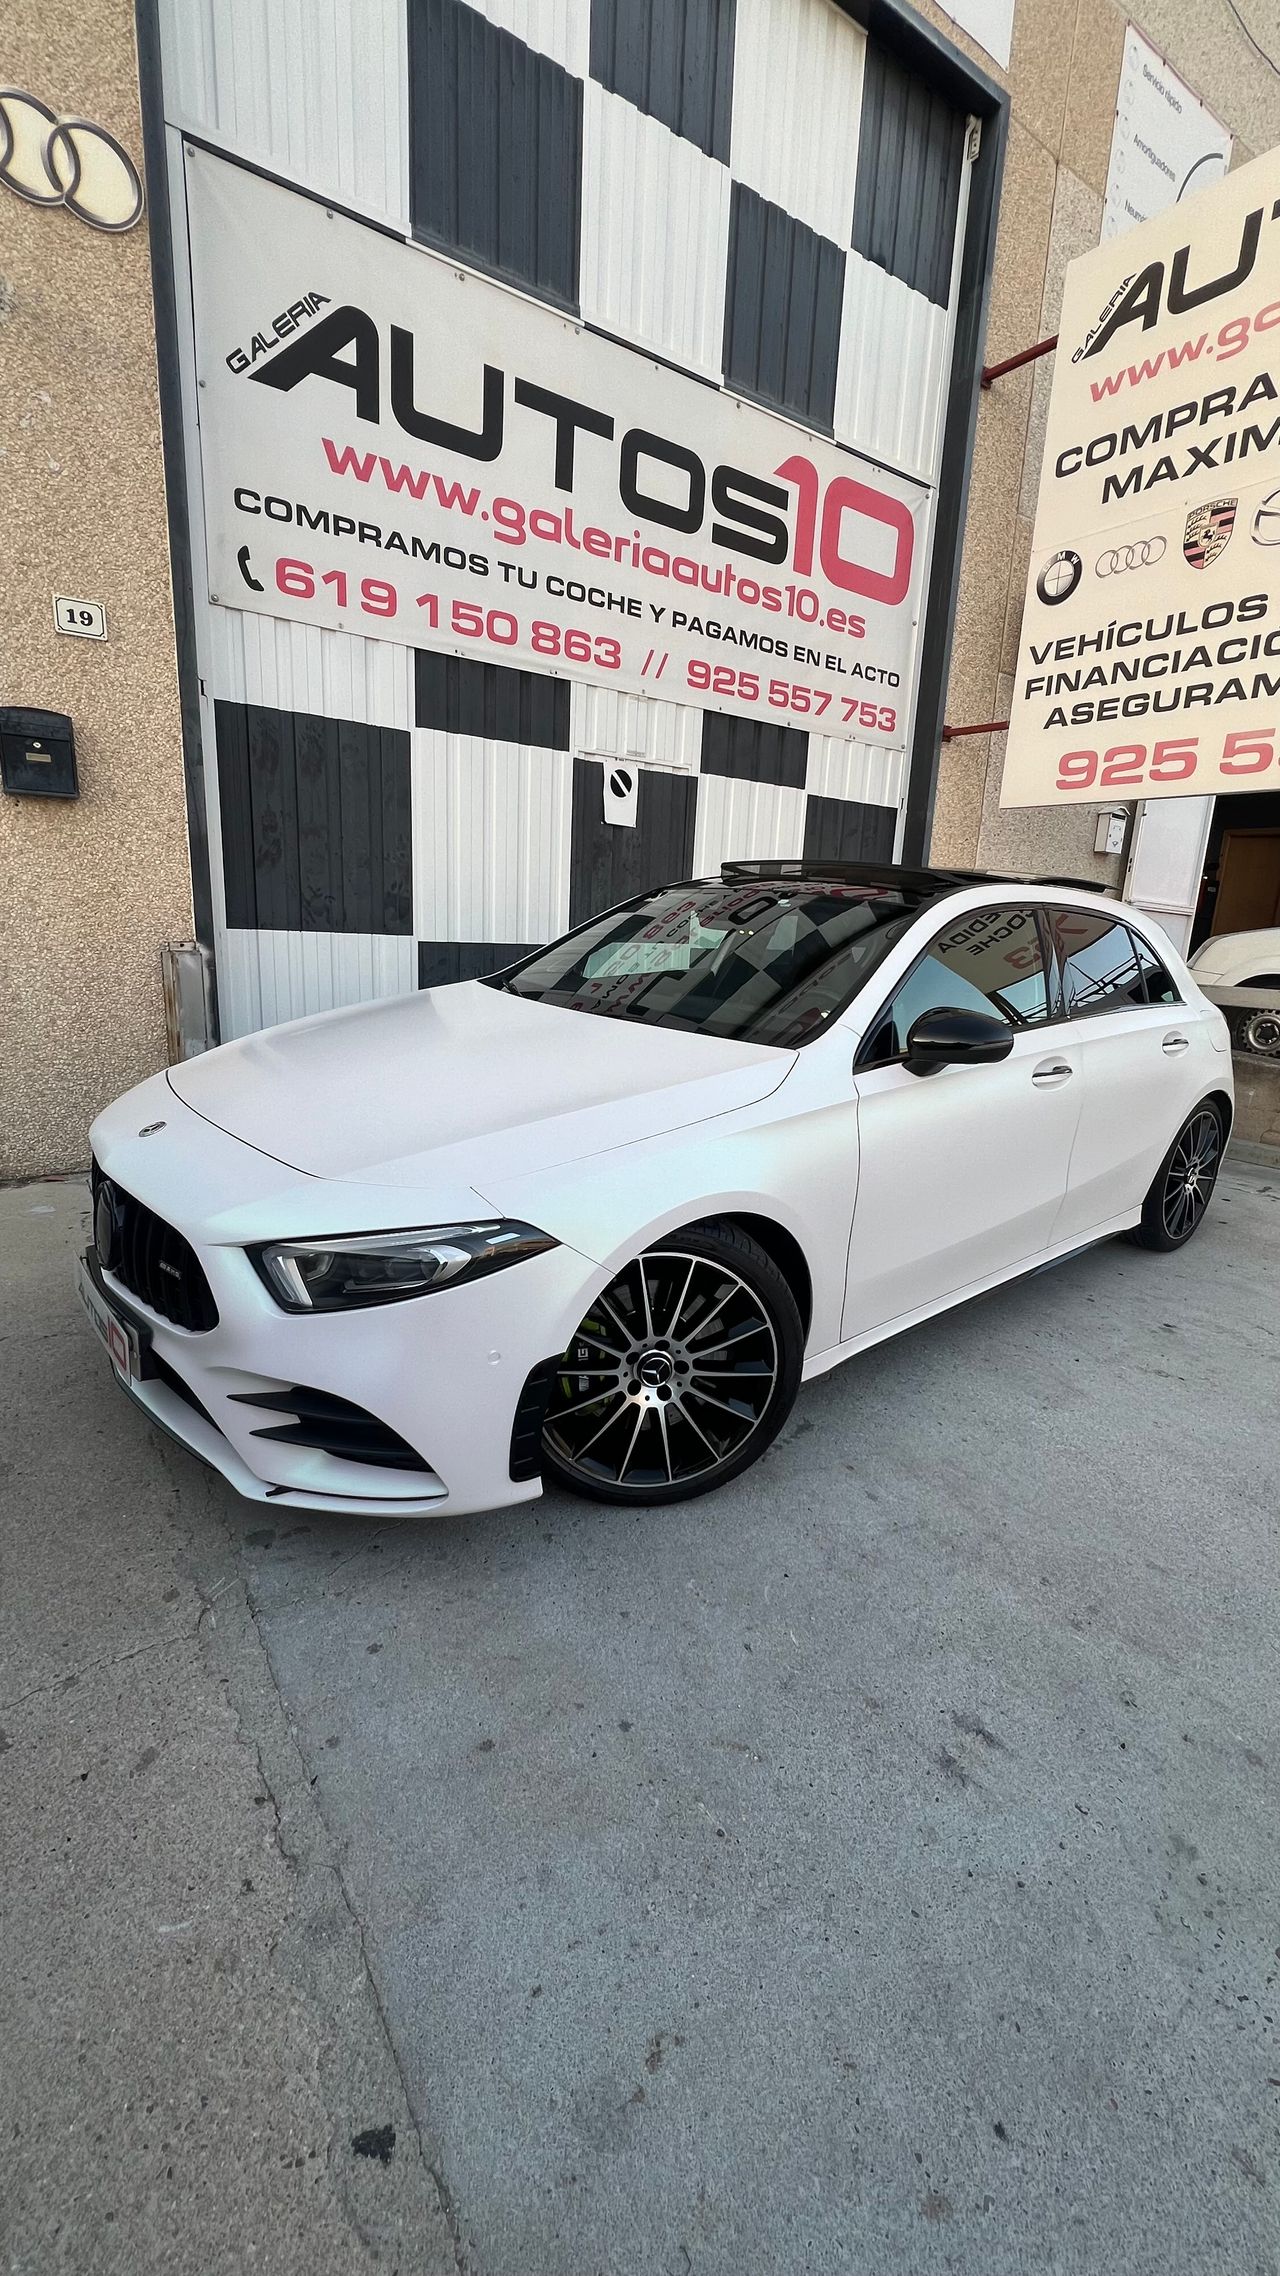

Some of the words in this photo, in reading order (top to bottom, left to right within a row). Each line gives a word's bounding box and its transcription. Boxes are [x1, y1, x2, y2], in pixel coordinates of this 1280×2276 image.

[225, 291, 331, 374] GALERIA
[1071, 273, 1137, 364] GALERIA
[1081, 198, 1280, 361] AU
[247, 305, 915, 606] AUTOS10
[1055, 372, 1279, 478] COMPRA
[233, 487, 489, 577] COMPRAMOS
[497, 561, 538, 590] TU
[546, 575, 643, 619] COCHE
[649, 604, 666, 623] Y
[672, 611, 789, 658] PAGAMOS
[793, 644, 820, 667] EN
[825, 655, 847, 675] EL
[850, 662, 900, 688] ACTO
[321, 437, 866, 638] www.galeriaautos10.es
[66, 608, 94, 627] 19
[275, 557, 398, 618] 619
[416, 593, 519, 646] 150
[531, 620, 622, 670] 863
[687, 659, 760, 702] 925
[768, 679, 833, 717] 557
[840, 697, 897, 733] 753
[1029, 594, 1269, 666] VEHÍCULOS
[1055, 737, 1200, 791] 925
[1219, 727, 1280, 776] 5
